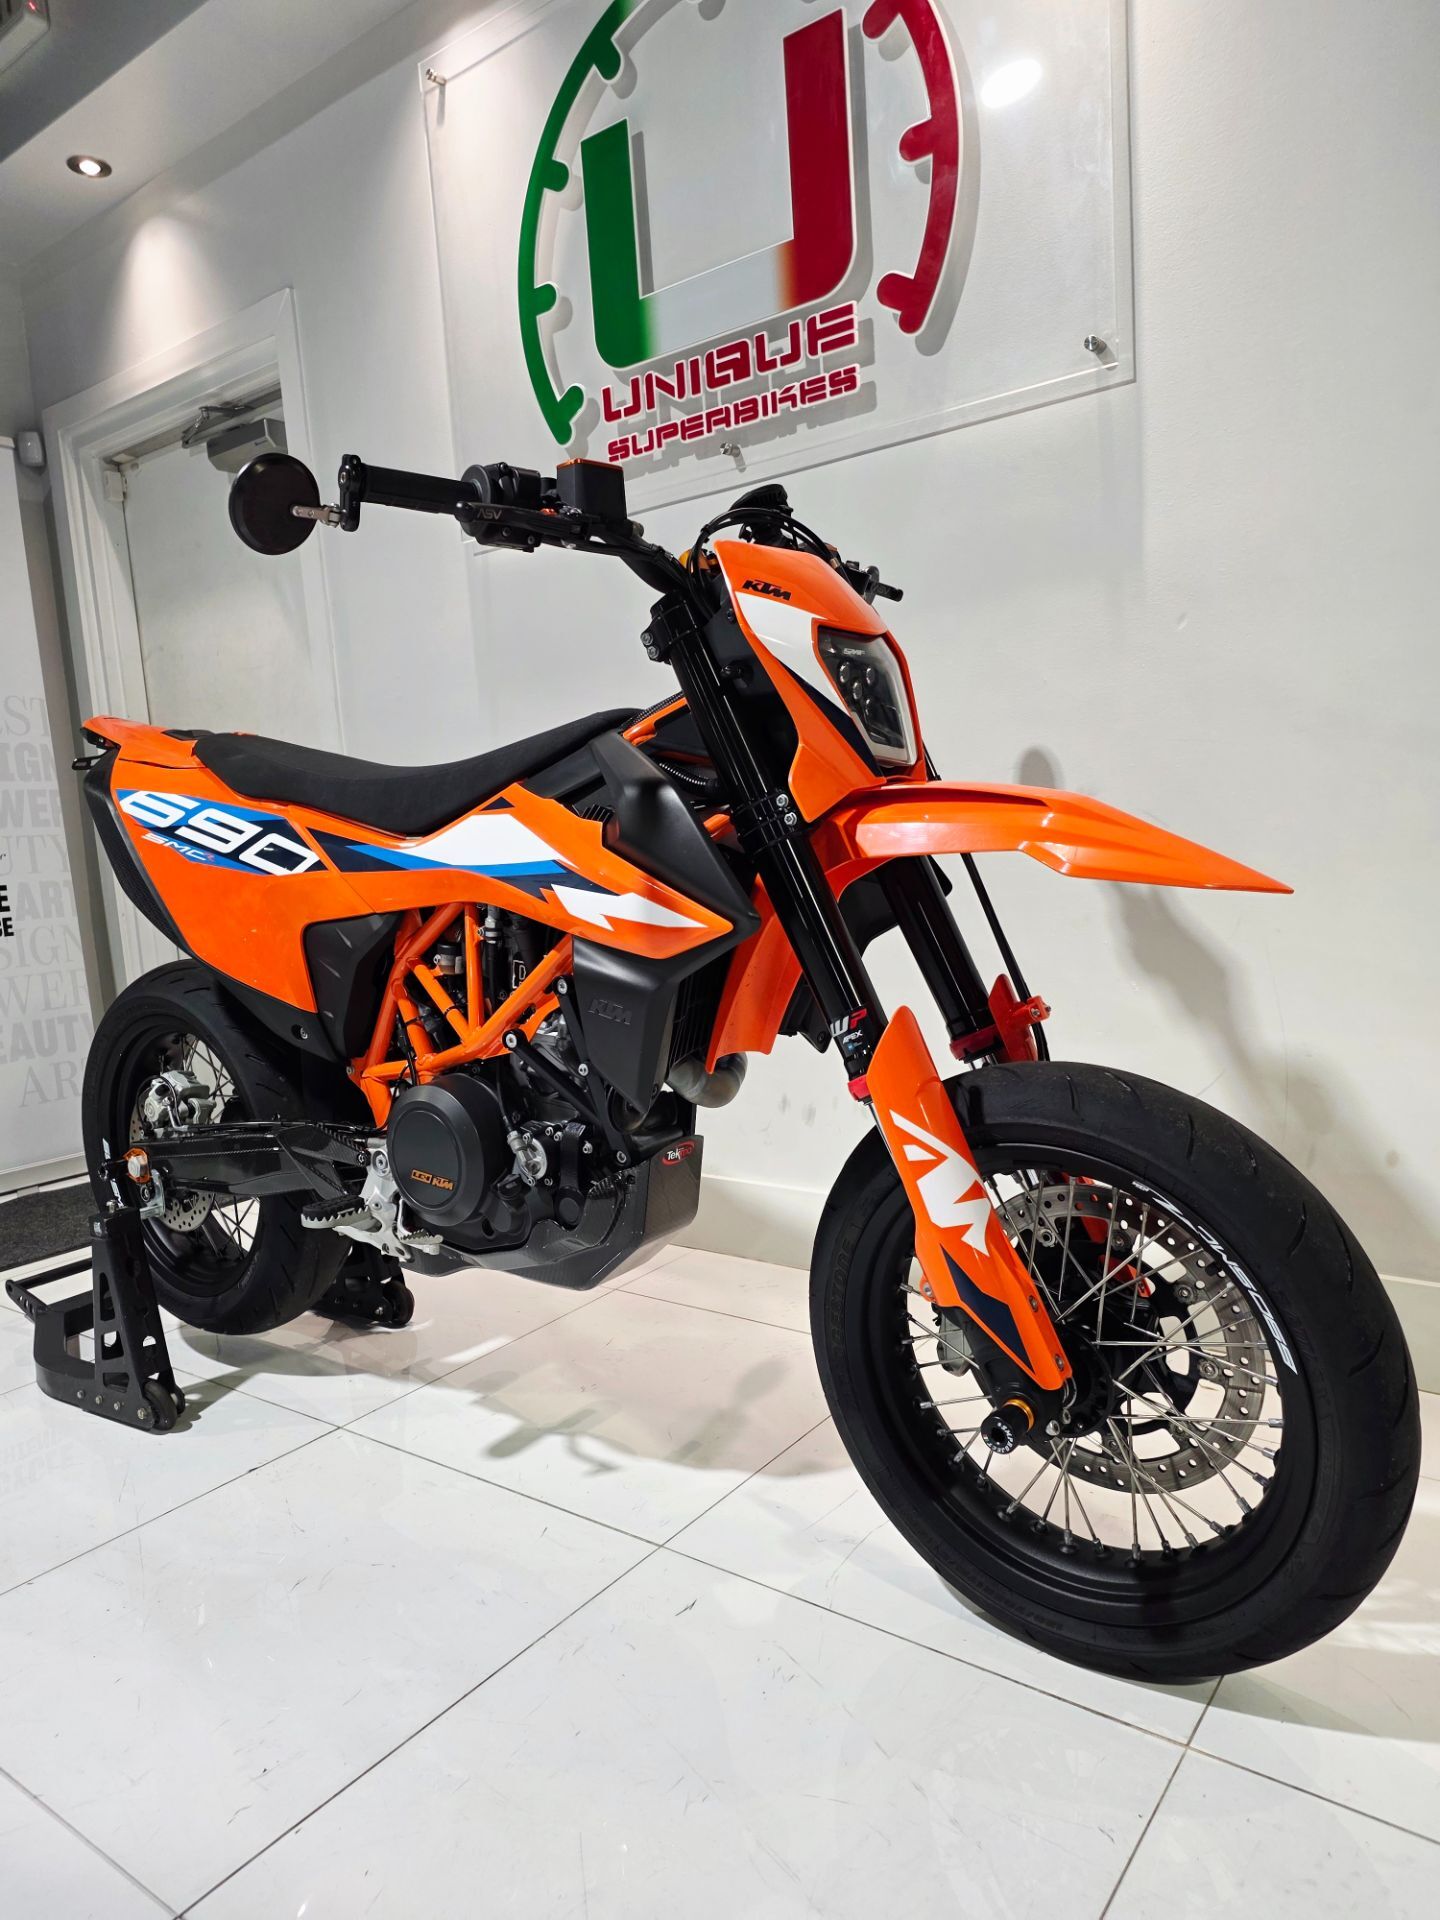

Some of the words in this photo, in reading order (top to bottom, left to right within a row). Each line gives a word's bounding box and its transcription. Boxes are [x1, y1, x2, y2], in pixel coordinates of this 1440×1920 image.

[602, 300, 857, 423] UNIQUE
[606, 365, 859, 462] SUPERBIKES
[742, 579, 792, 601] KTM
[119, 790, 320, 877] 690
[587, 999, 633, 1026] KTM
[829, 1008, 868, 1038] WP
[431, 1176, 454, 1191] KTM
